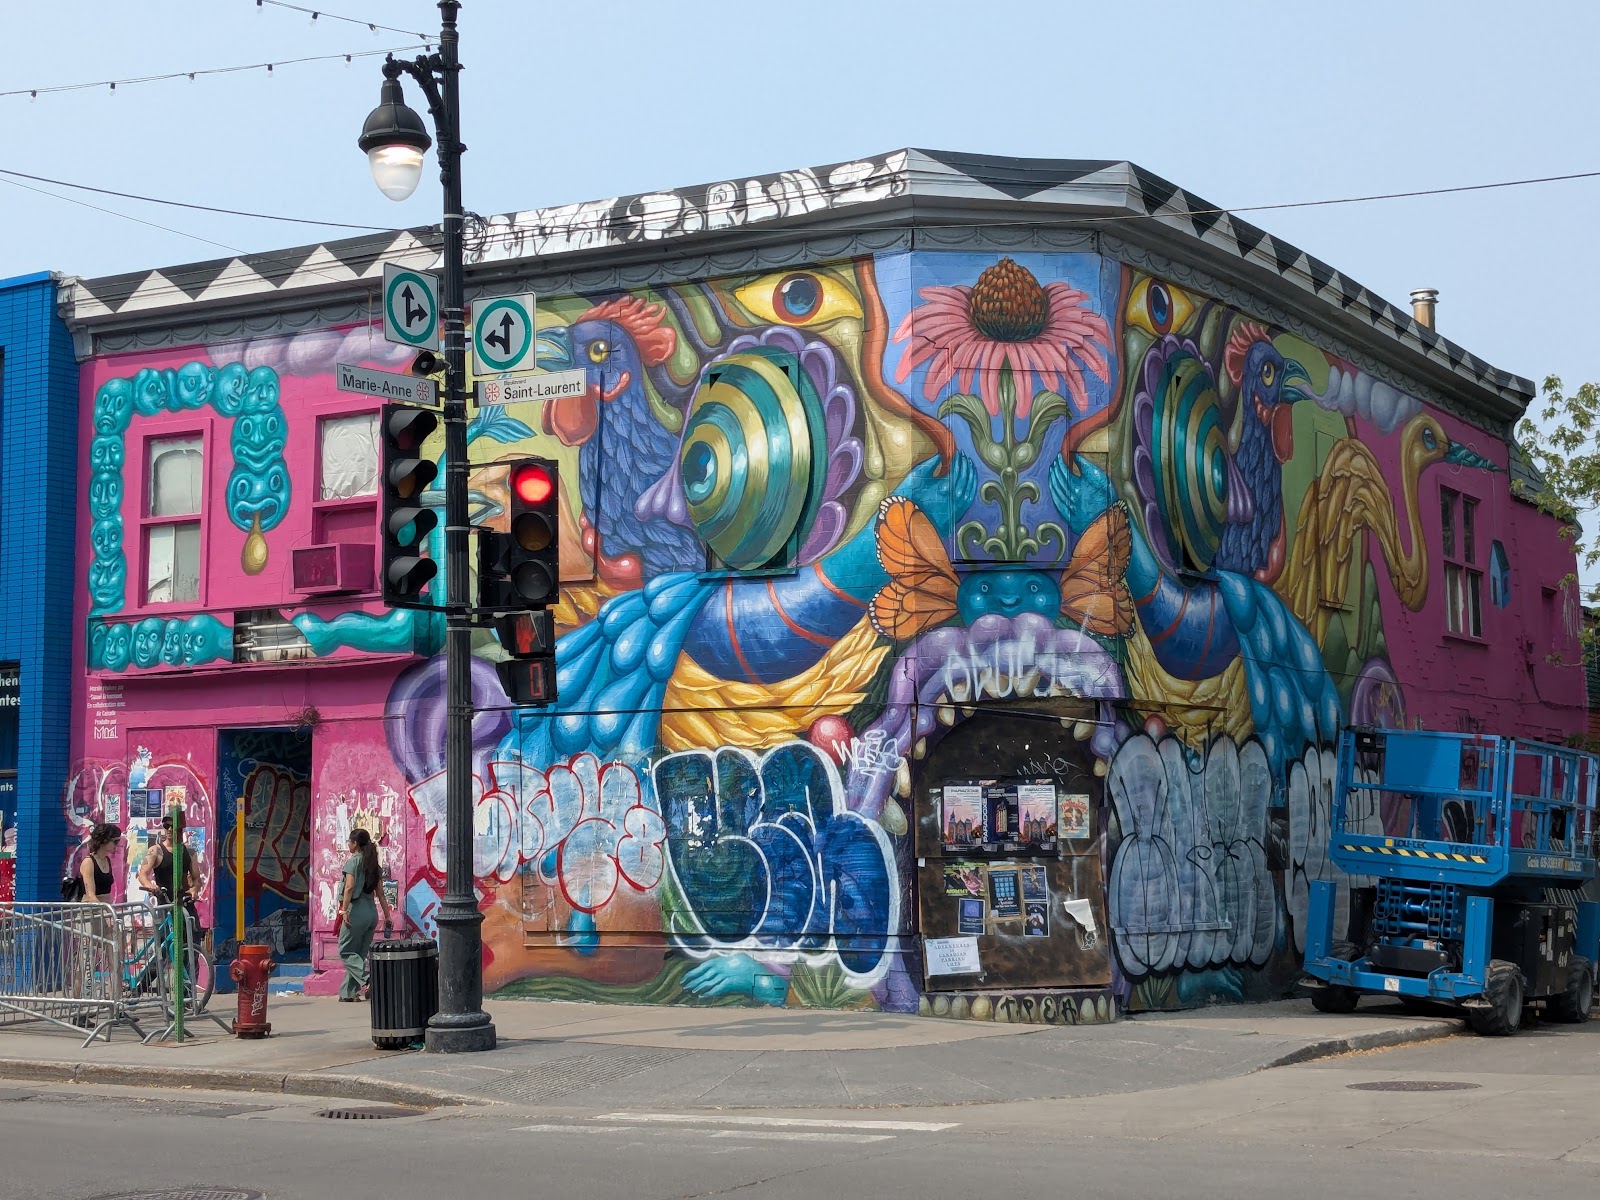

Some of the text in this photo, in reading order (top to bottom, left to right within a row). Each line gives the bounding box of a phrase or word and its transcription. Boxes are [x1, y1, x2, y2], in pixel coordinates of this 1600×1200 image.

[343, 374, 412, 398] Marie-Anne
[504, 380, 581, 400] Saint-Laurent
[1394, 839, 1428, 849] LOU-TEC
